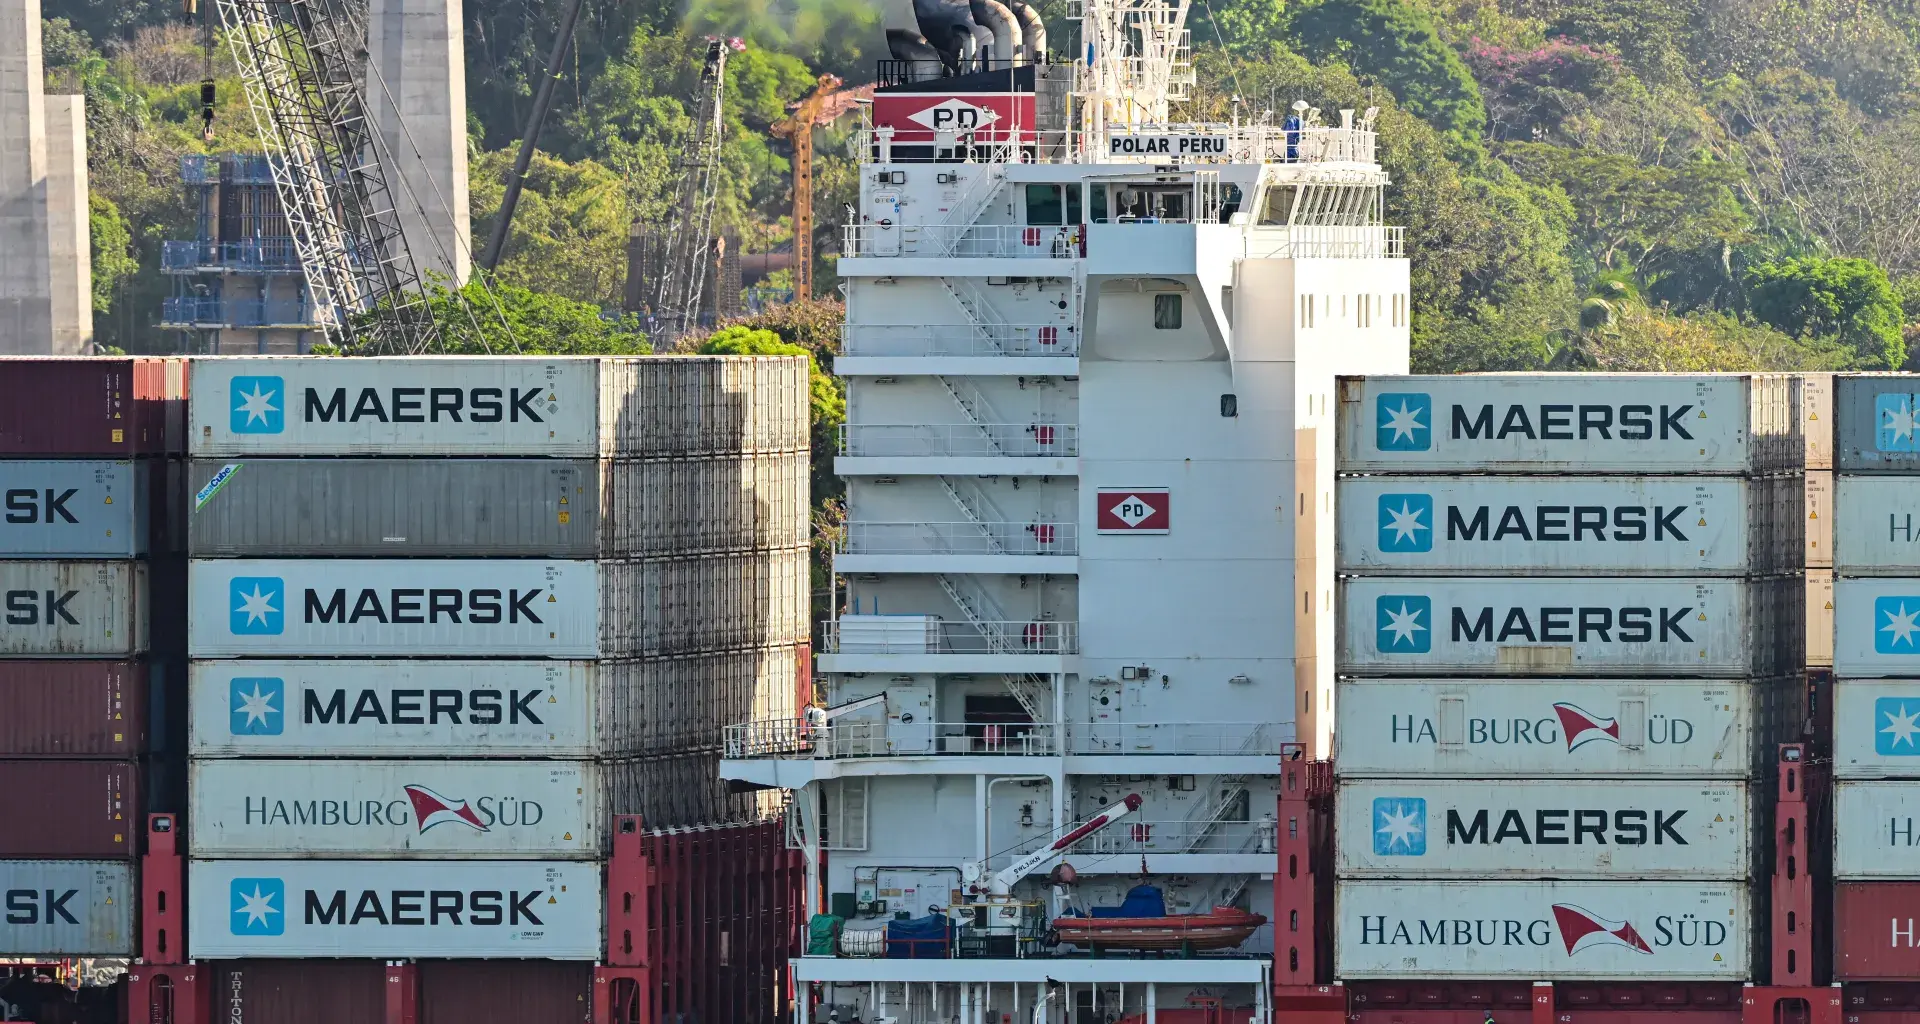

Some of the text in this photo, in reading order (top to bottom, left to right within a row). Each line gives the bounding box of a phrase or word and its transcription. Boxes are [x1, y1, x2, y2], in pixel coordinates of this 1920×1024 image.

[934, 109, 978, 129] PD
[1111, 138, 1224, 153] POLAR PERU
[304, 387, 544, 423] MAERSK
[1451, 404, 1695, 440] MAERSK
[197, 467, 231, 501] SeaCube
[5, 488, 80, 524] SK
[1122, 503, 1144, 517] PD
[1447, 505, 1690, 541] MAERSK
[1890, 513, 1920, 542] H
[6, 589, 80, 625] SK
[304, 588, 544, 624] MAERSK
[1451, 606, 1695, 643] MAERSK
[304, 688, 544, 725] MAERSK
[1392, 714, 1694, 745] HABURG ÜD
[245, 795, 543, 828] HAMBURG SÜD
[1446, 809, 1689, 845] MAERSK
[1891, 817, 1920, 846] H
[5, 889, 80, 925] SK
[304, 889, 544, 925] MAERSK
[1359, 913, 1727, 947] HAMBURG SÜD
[1891, 917, 1920, 948] H
[231, 971, 243, 1024] TRITON
[1852, 996, 1865, 1004] 39
